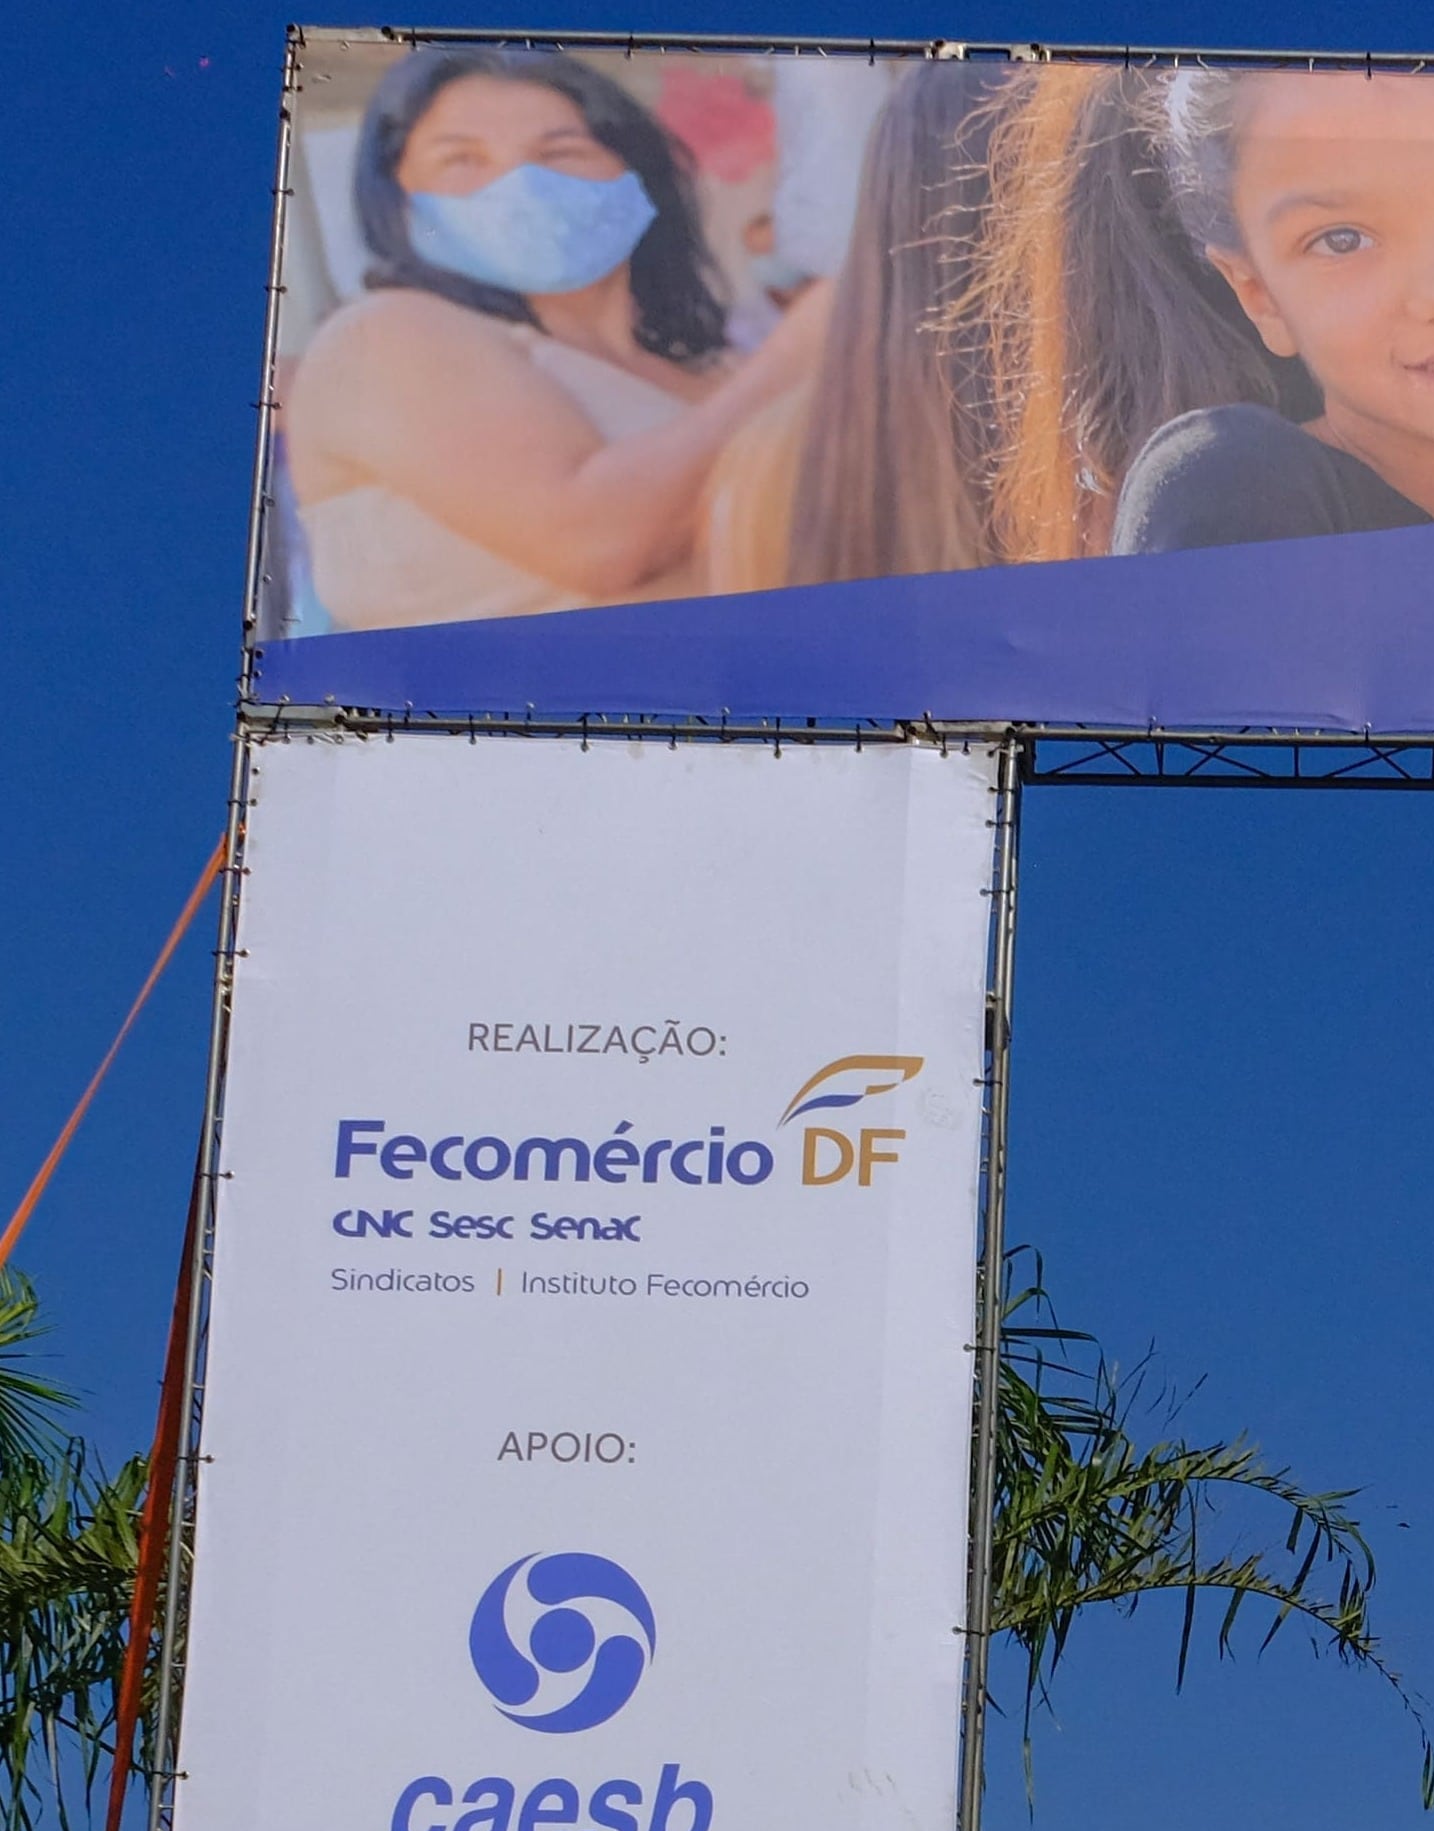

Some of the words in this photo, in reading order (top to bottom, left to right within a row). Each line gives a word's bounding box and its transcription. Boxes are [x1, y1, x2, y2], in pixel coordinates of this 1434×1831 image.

[469, 1020, 726, 1063] REALIZAÇÃO:
[335, 1120, 773, 1185] Fecomércio
[802, 1128, 905, 1186] DF
[333, 1210, 413, 1237] CNC
[429, 1211, 514, 1239] Sesc
[332, 1269, 474, 1292] Sindicatos
[523, 1272, 636, 1295] Instituto
[648, 1274, 809, 1298] Fecomércio
[498, 1432, 635, 1463] APOIO:
